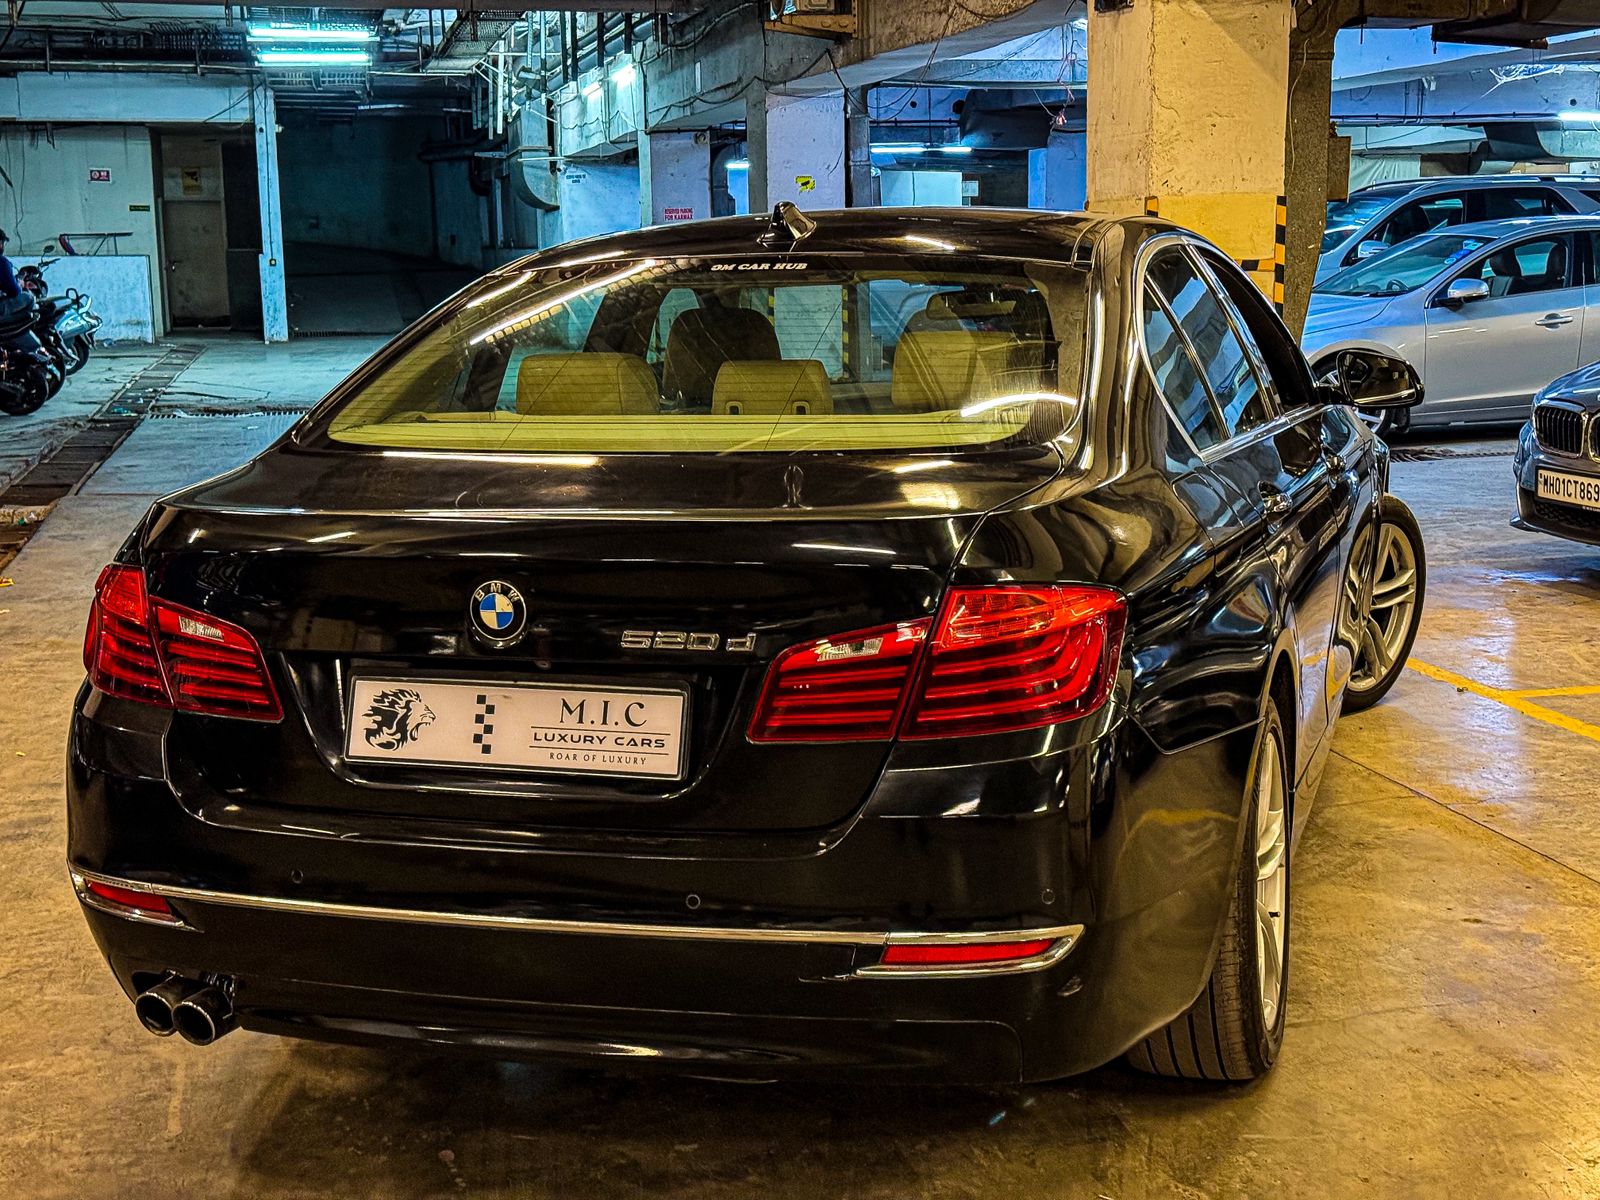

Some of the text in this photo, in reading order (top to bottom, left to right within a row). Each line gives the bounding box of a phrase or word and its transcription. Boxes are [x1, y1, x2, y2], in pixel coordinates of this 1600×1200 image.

[474, 582, 520, 602] BMW
[559, 698, 647, 727] M.I.C
[533, 732, 666, 748] LUXURY CARS
[549, 752, 647, 765] ROAR OF LUXURY
